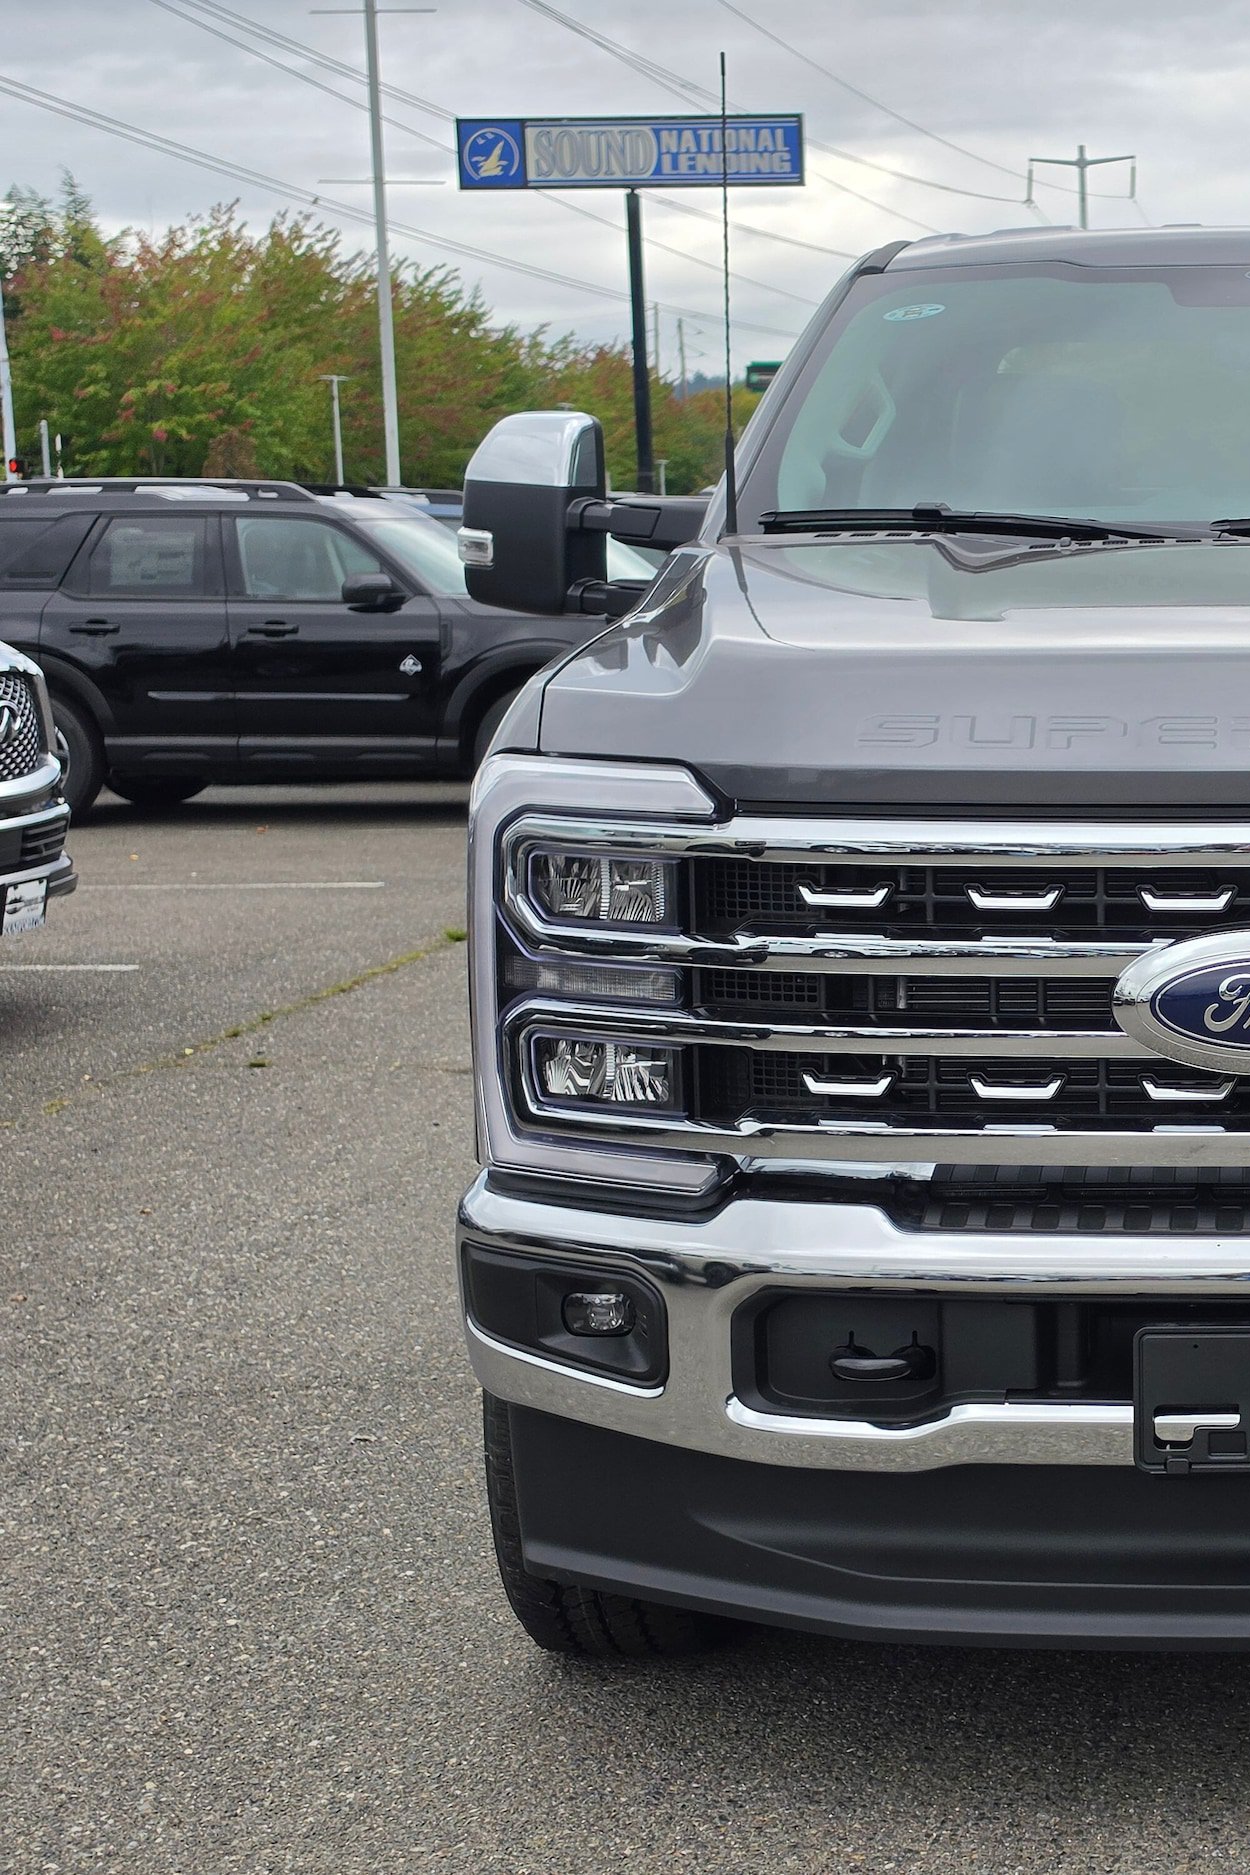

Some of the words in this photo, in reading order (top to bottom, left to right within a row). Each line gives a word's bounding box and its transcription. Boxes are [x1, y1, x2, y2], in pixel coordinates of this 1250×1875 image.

[533, 128, 653, 177] SOUND
[659, 127, 790, 154] NATIONAL
[660, 152, 792, 175] LENDING
